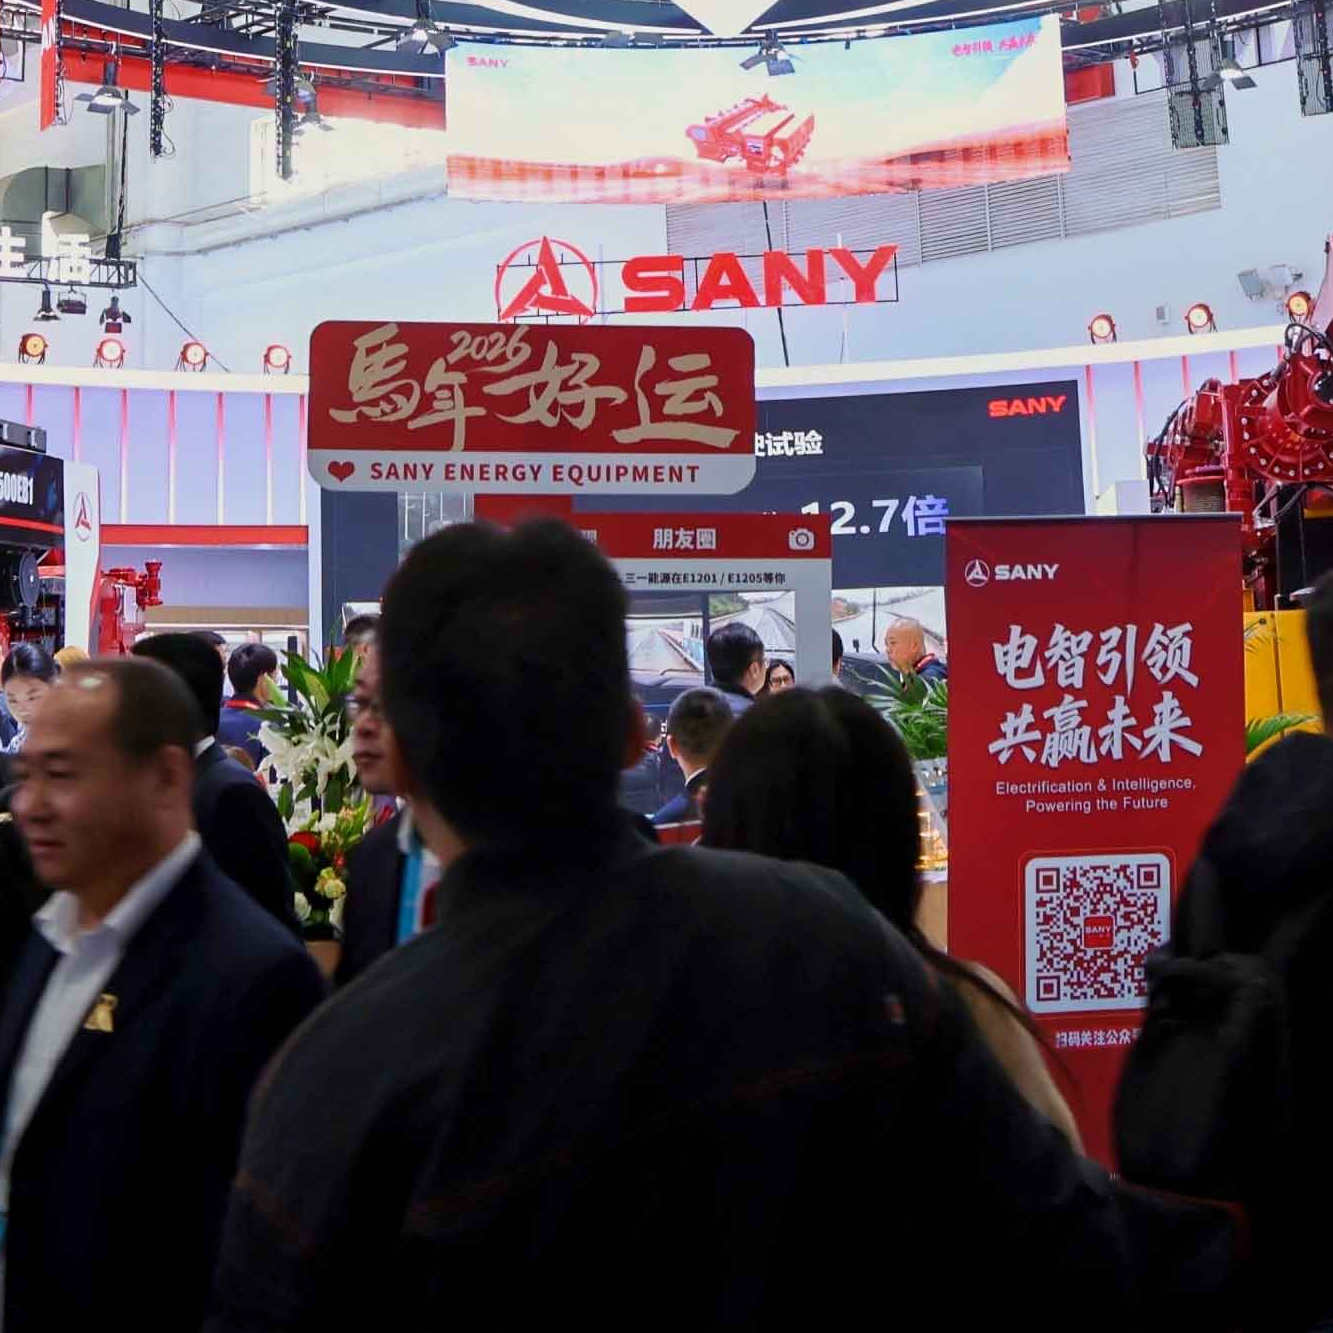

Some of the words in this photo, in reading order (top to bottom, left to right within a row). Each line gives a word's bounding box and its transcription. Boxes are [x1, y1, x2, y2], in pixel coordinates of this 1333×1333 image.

[466, 56, 510, 68] SANY
[621, 245, 898, 313] SANY
[445, 324, 534, 374] 2026
[988, 395, 1066, 418] SANY
[370, 461, 435, 481] SANY
[444, 462, 542, 484] ENERGY
[552, 464, 700, 485] EQUIPMENT
[652, 527, 716, 550] 朋友圈
[994, 564, 1059, 581] SANY
[992, 622, 1200, 695] 电智引领
[988, 690, 1203, 768] 共赢未来
[995, 780, 1092, 795] Electrification
[1097, 781, 1107, 792] &
[1026, 799, 1091, 814] Powering
[1096, 798, 1117, 810] the
[1123, 796, 1169, 809] Future
[1085, 925, 1112, 934] SANY
